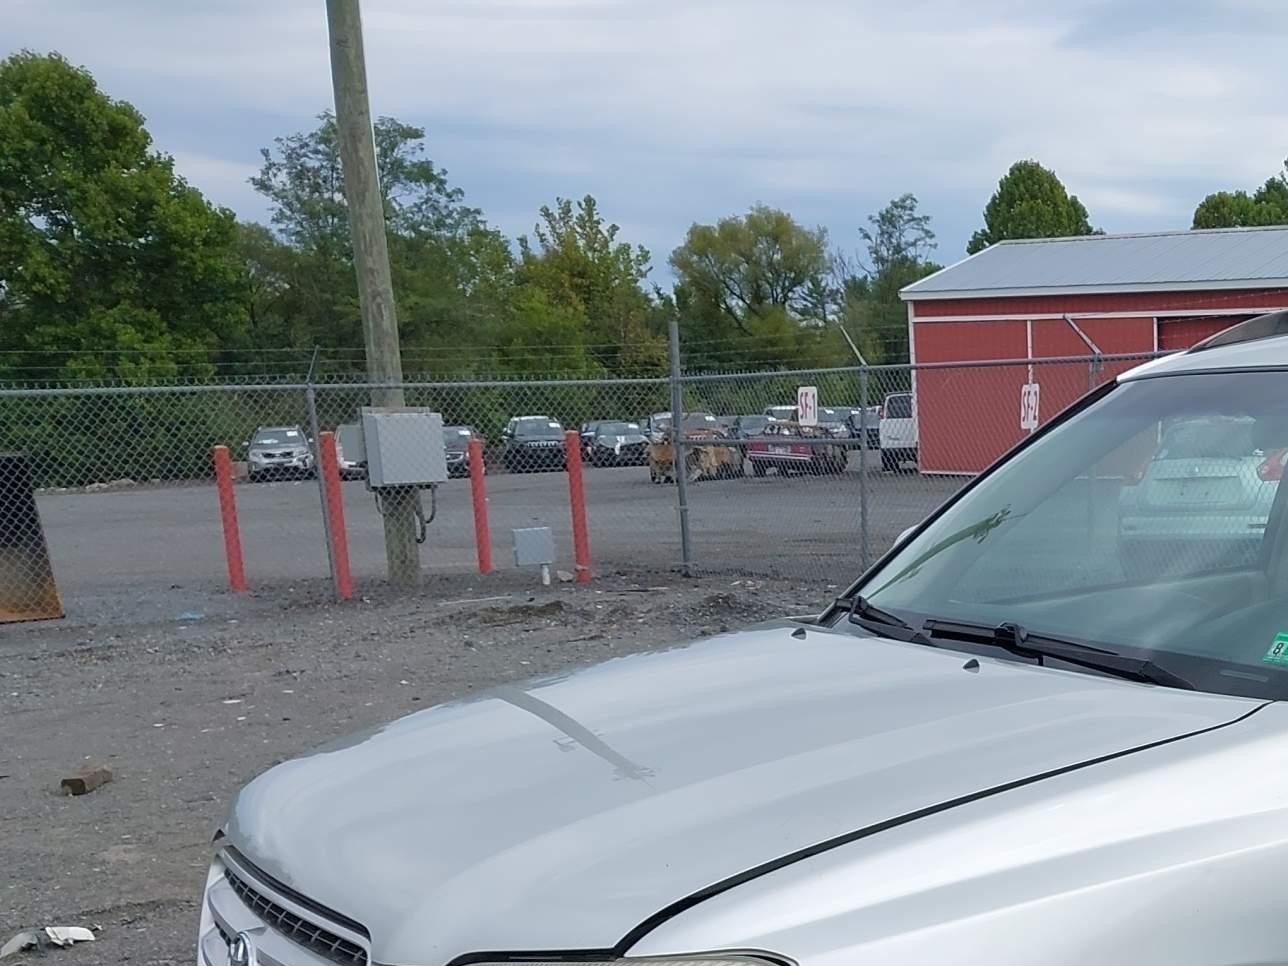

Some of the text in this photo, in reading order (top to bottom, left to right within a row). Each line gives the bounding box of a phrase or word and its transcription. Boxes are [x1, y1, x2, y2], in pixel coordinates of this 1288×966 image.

[799, 391, 816, 420] SF-1
[1022, 390, 1038, 422] SF-2
[1272, 642, 1285, 655] 8
